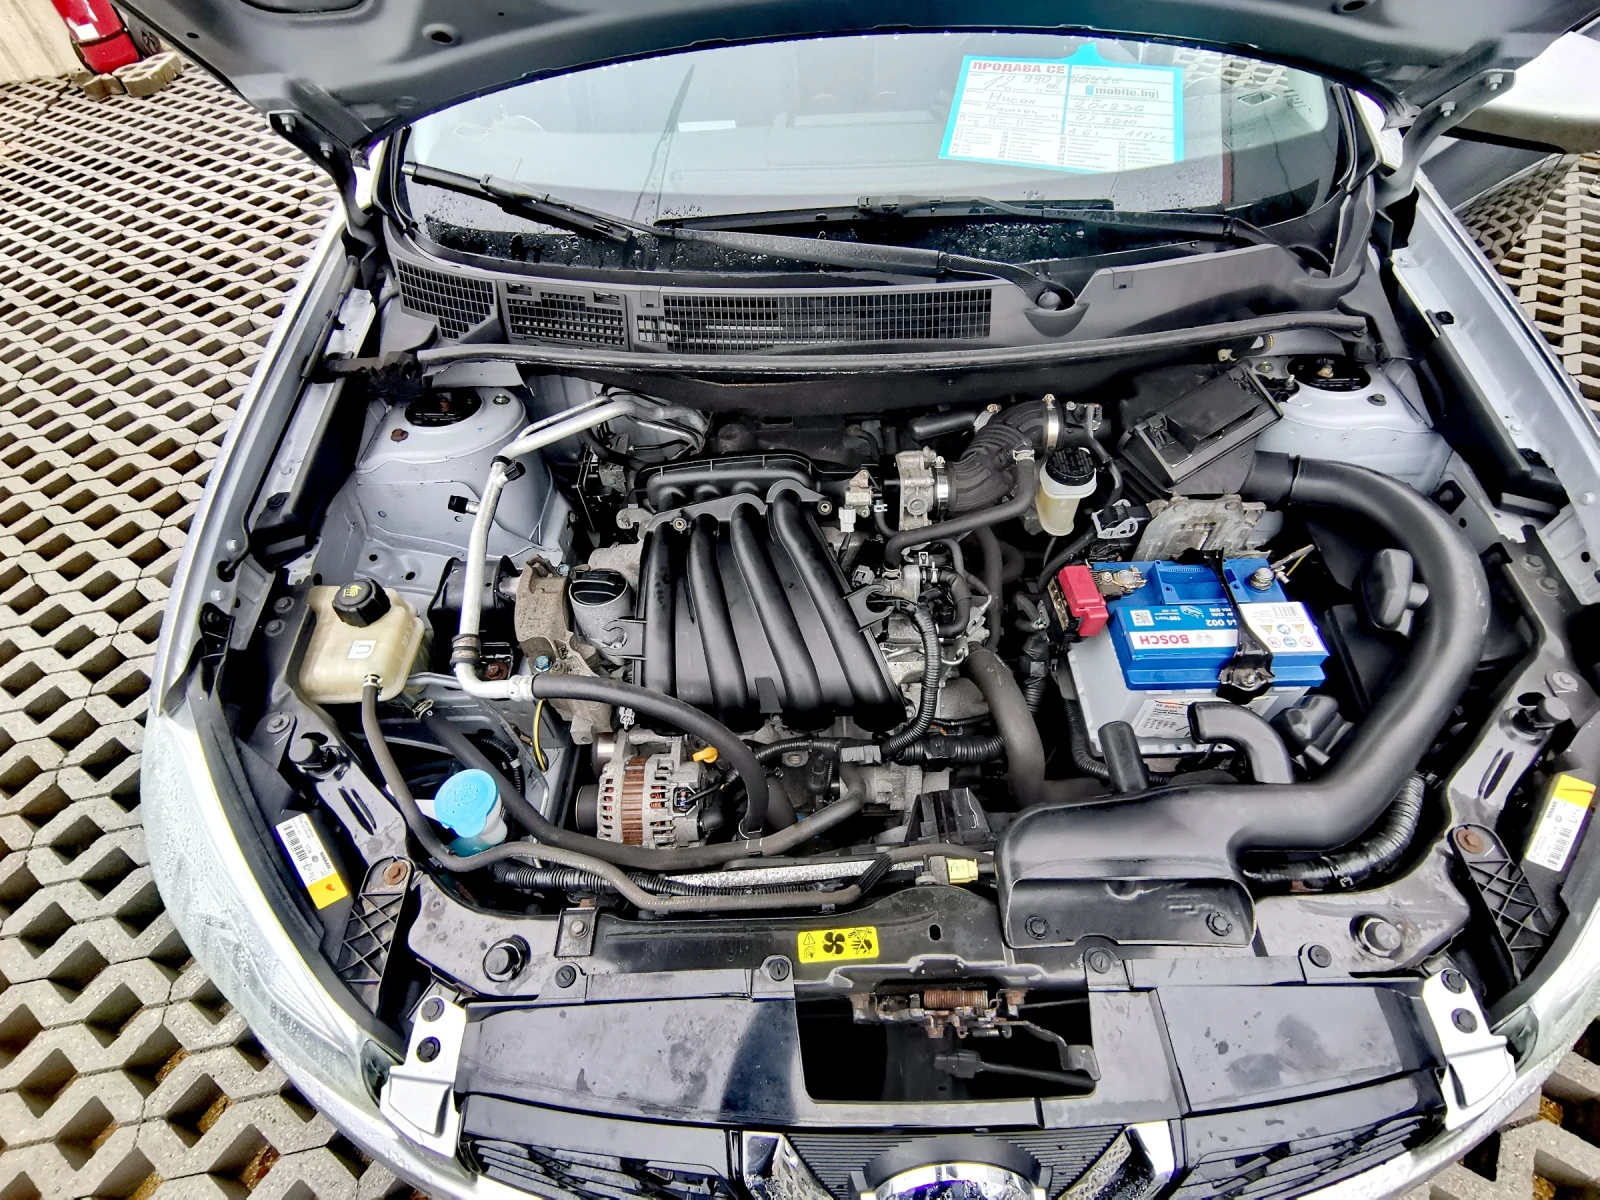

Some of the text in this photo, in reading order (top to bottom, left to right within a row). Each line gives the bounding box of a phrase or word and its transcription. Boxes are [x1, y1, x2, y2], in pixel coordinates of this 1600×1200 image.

[972, 62, 1041, 72] ПРОДАВА
[1046, 64, 1065, 74] СЕ
[1095, 87, 1156, 98] mobile.bg
[1074, 101, 1145, 112] 201236
[1139, 634, 1190, 645] BOSCH
